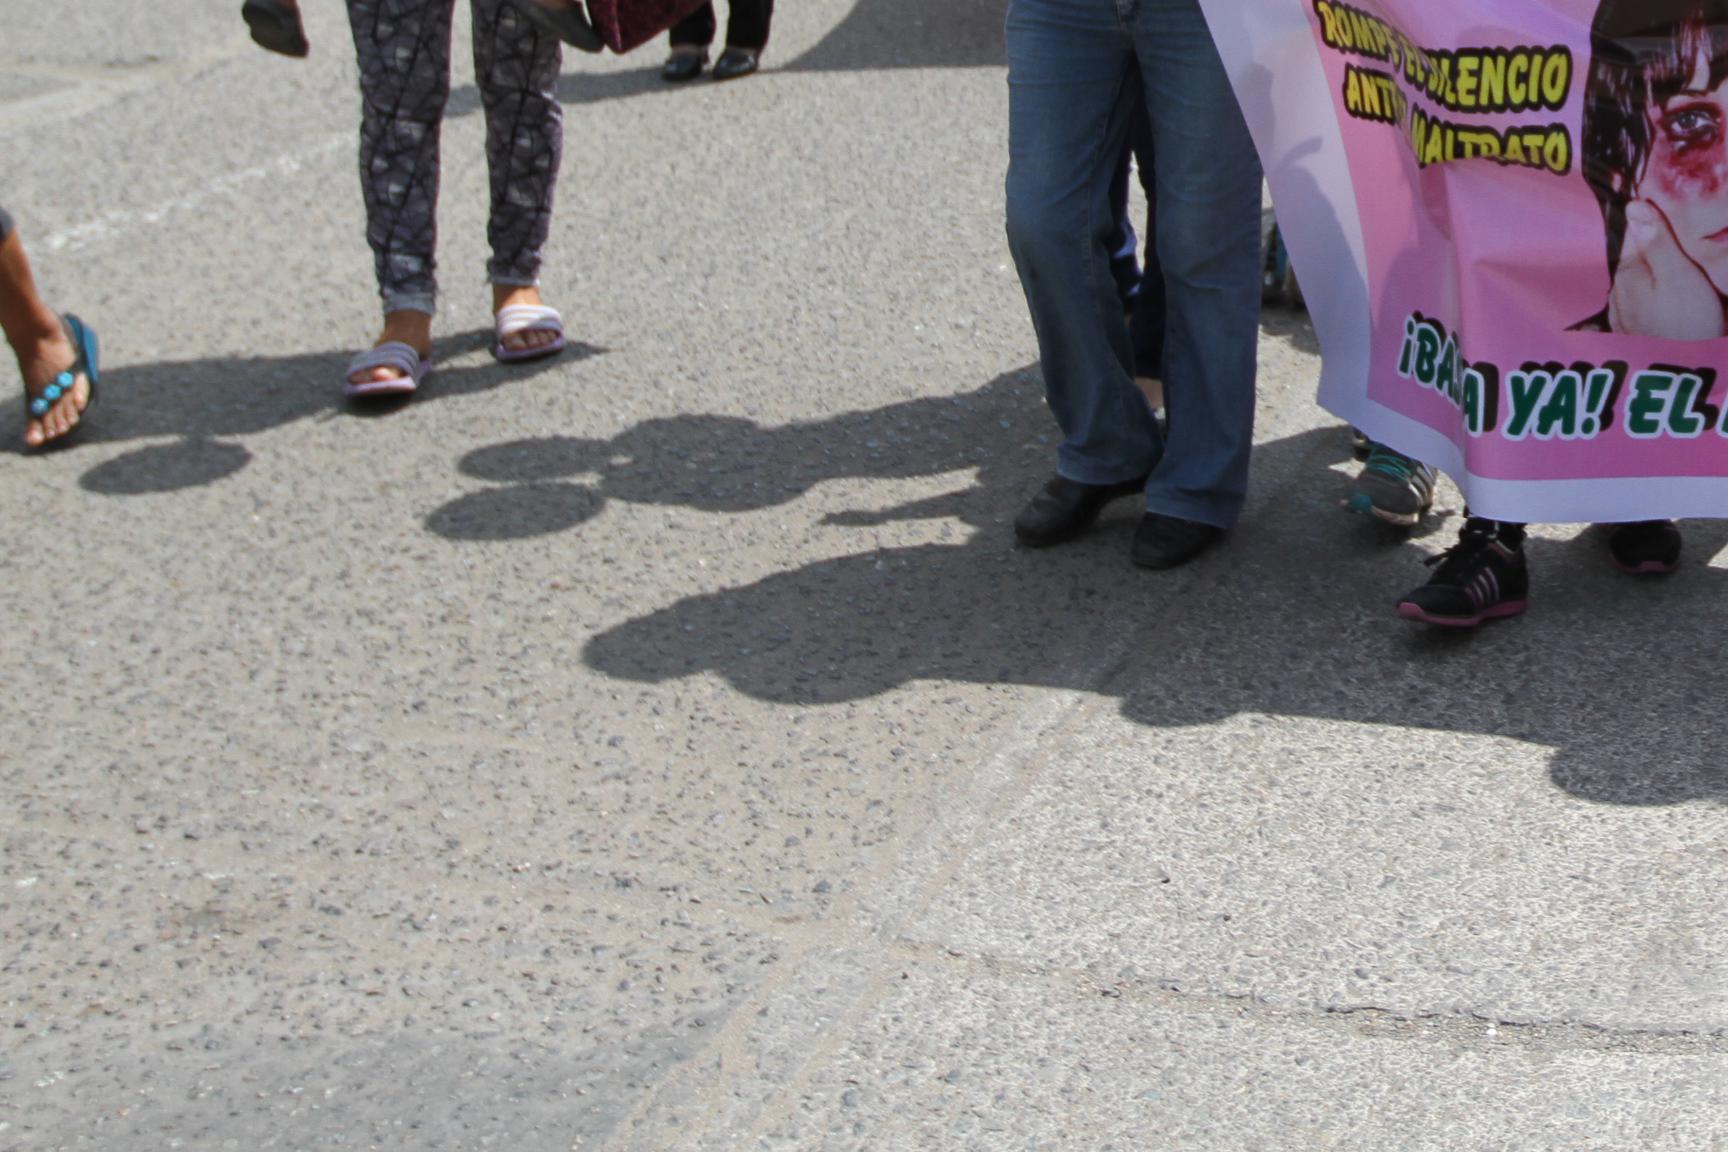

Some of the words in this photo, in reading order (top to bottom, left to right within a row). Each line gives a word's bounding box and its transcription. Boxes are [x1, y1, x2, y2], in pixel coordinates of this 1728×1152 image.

[1420, 46, 1572, 112] SILENCIO
[1503, 367, 1614, 441] YA!
[1624, 368, 1707, 439] EL
